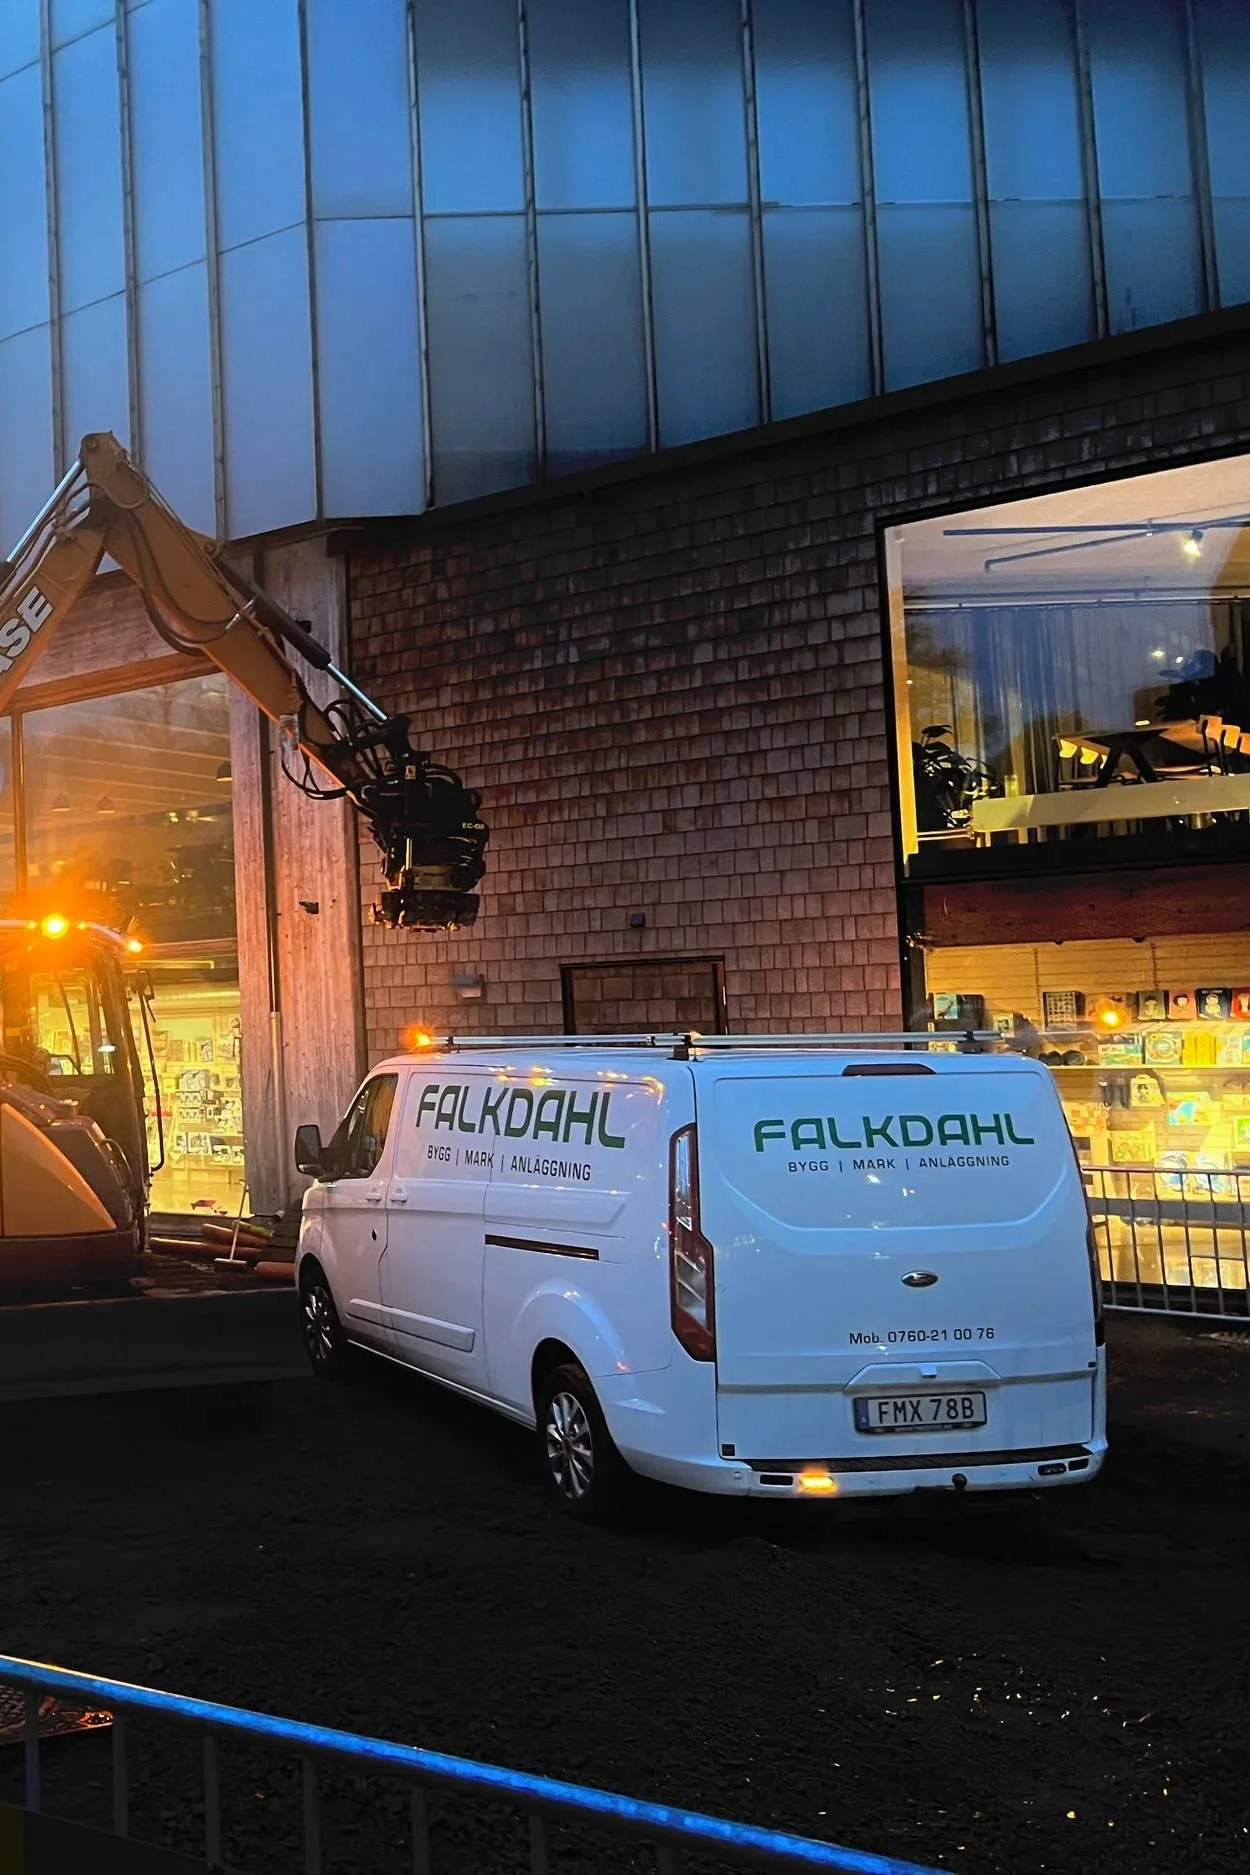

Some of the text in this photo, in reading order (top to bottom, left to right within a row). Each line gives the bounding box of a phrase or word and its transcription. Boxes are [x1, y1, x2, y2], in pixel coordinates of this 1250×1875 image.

[415, 1084, 626, 1149] FALKDAHL
[753, 1113, 1035, 1153] FALKDAHL
[427, 1144, 592, 1181] BYGG MARK ANLÄGGNING
[788, 1155, 1010, 1173] BYGG MARK ANLÄGGNING
[888, 1329, 947, 1343] 0760-21
[954, 1328, 972, 1340] 00
[977, 1327, 995, 1340] 76
[878, 1397, 975, 1425] FMX 78B
